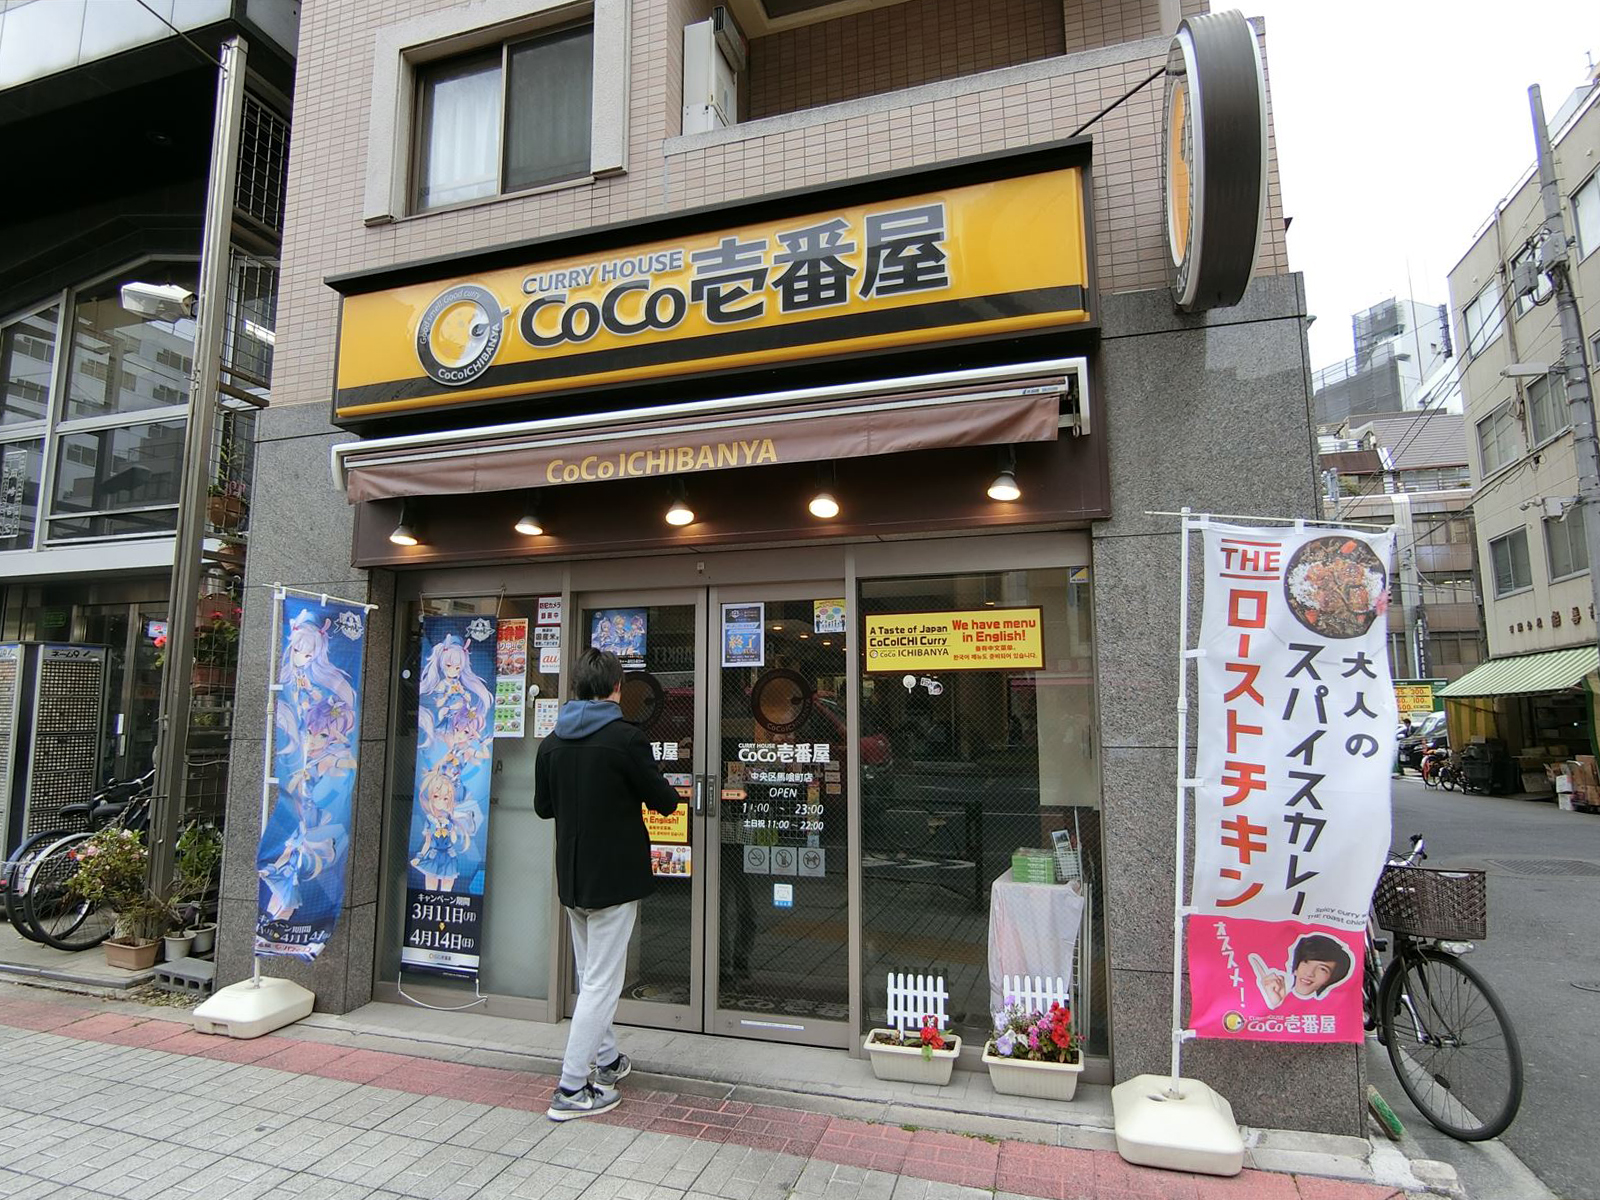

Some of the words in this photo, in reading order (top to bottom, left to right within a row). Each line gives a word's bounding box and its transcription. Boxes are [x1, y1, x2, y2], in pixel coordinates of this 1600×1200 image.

[522, 267, 595, 295] CURRY
[601, 250, 683, 283] HOUSE
[619, 439, 777, 477] ICHIBANYA
[1220, 548, 1280, 571] THE
[870, 626, 876, 635] A
[879, 626, 905, 634] Taste
[908, 625, 917, 634] of
[920, 625, 947, 634] Japan
[952, 620, 968, 630] We
[972, 619, 1000, 630] have
[1003, 620, 1036, 628] menu
[870, 637, 917, 647] CoCoICHI
[920, 636, 947, 645] Curry
[963, 632, 973, 642] in
[976, 630, 1026, 642] English!
[898, 648, 949, 657] ICHIBANYA
[1341, 651, 1379, 758] 大人の
[1216, 589, 1268, 907] ローストチキン
[1283, 643, 1329, 915] スパイスカレー
[769, 787, 797, 798] OPEN
[795, 803, 824, 815] 23:00
[650, 816, 679, 824] English!
[743, 819, 765, 828] 土日祝
[768, 820, 789, 829] 11:00
[800, 821, 824, 831] 22:00
[418, 894, 471, 907] キャンペーン期間
[412, 903, 477, 924] 3月11日(月)
[1323, 914, 1344, 923] roast
[1337, 910, 1360, 918] curry
[410, 929, 475, 950] 4月14日(日)
